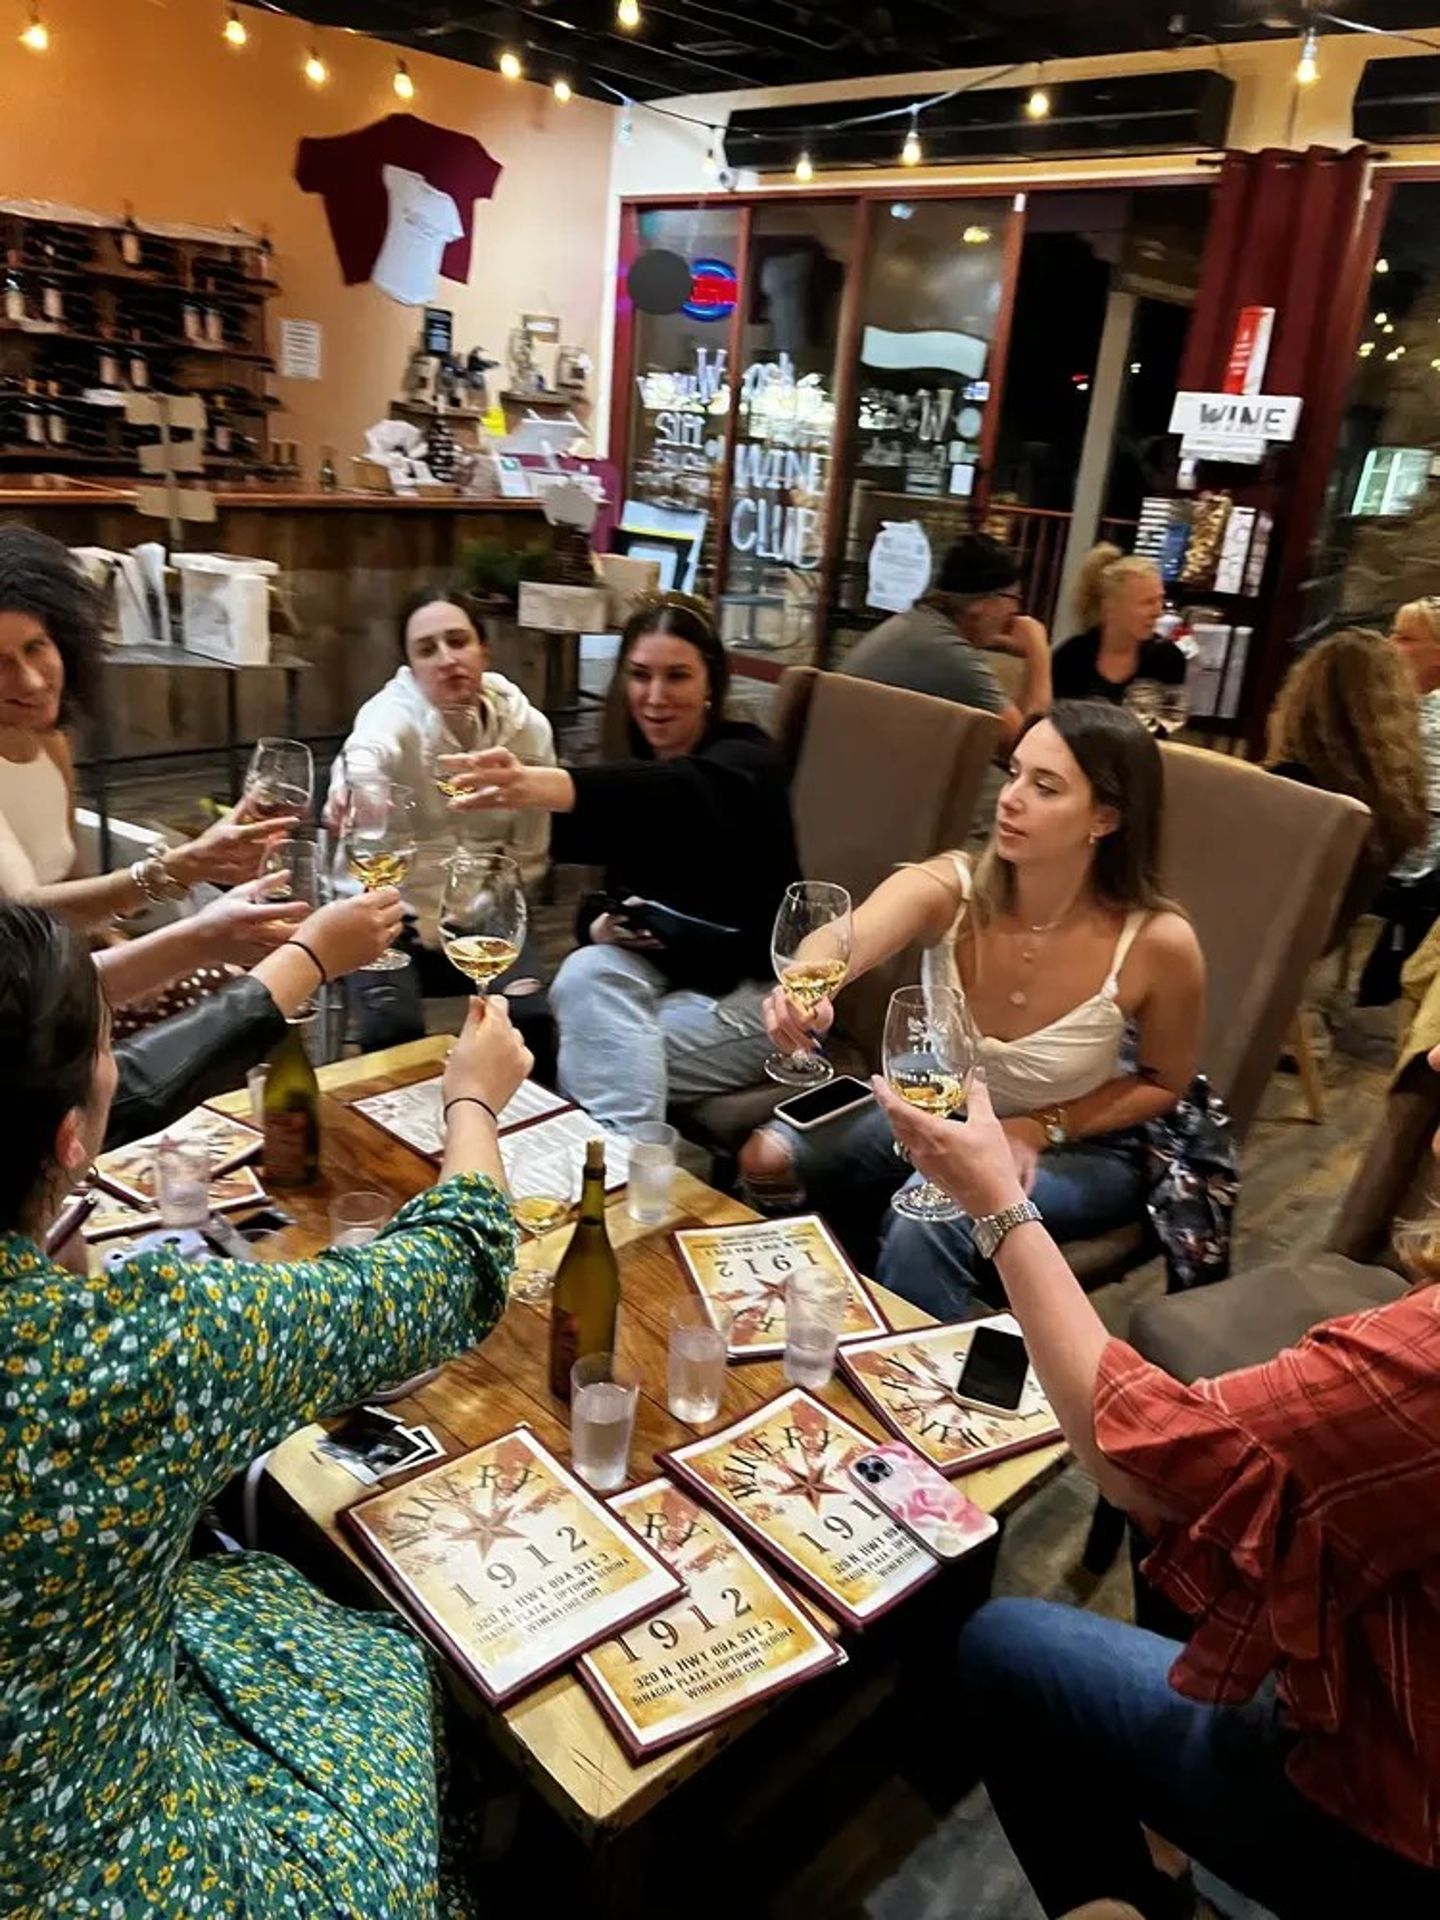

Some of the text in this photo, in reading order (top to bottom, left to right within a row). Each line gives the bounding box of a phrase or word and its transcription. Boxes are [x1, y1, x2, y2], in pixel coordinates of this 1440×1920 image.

[1201, 403, 1286, 431] WINE
[734, 443, 832, 495] WINE
[731, 498, 824, 569] CLUB
[723, 1425, 843, 1501] WINERY
[389, 1464, 544, 1552] WINERY
[799, 1499, 880, 1554] 191
[449, 1526, 588, 1609] 1912
[515, 1586, 547, 1609] HWY
[600, 1551, 611, 1564] 3
[611, 1587, 753, 1664] 1912
[633, 1670, 659, 1689] 320
[675, 1652, 710, 1673] HWY
[736, 1626, 763, 1644] STE
[763, 1619, 775, 1631] 3
[676, 1669, 709, 1690] PLAZA
[715, 1645, 760, 1671] UPTOWN
